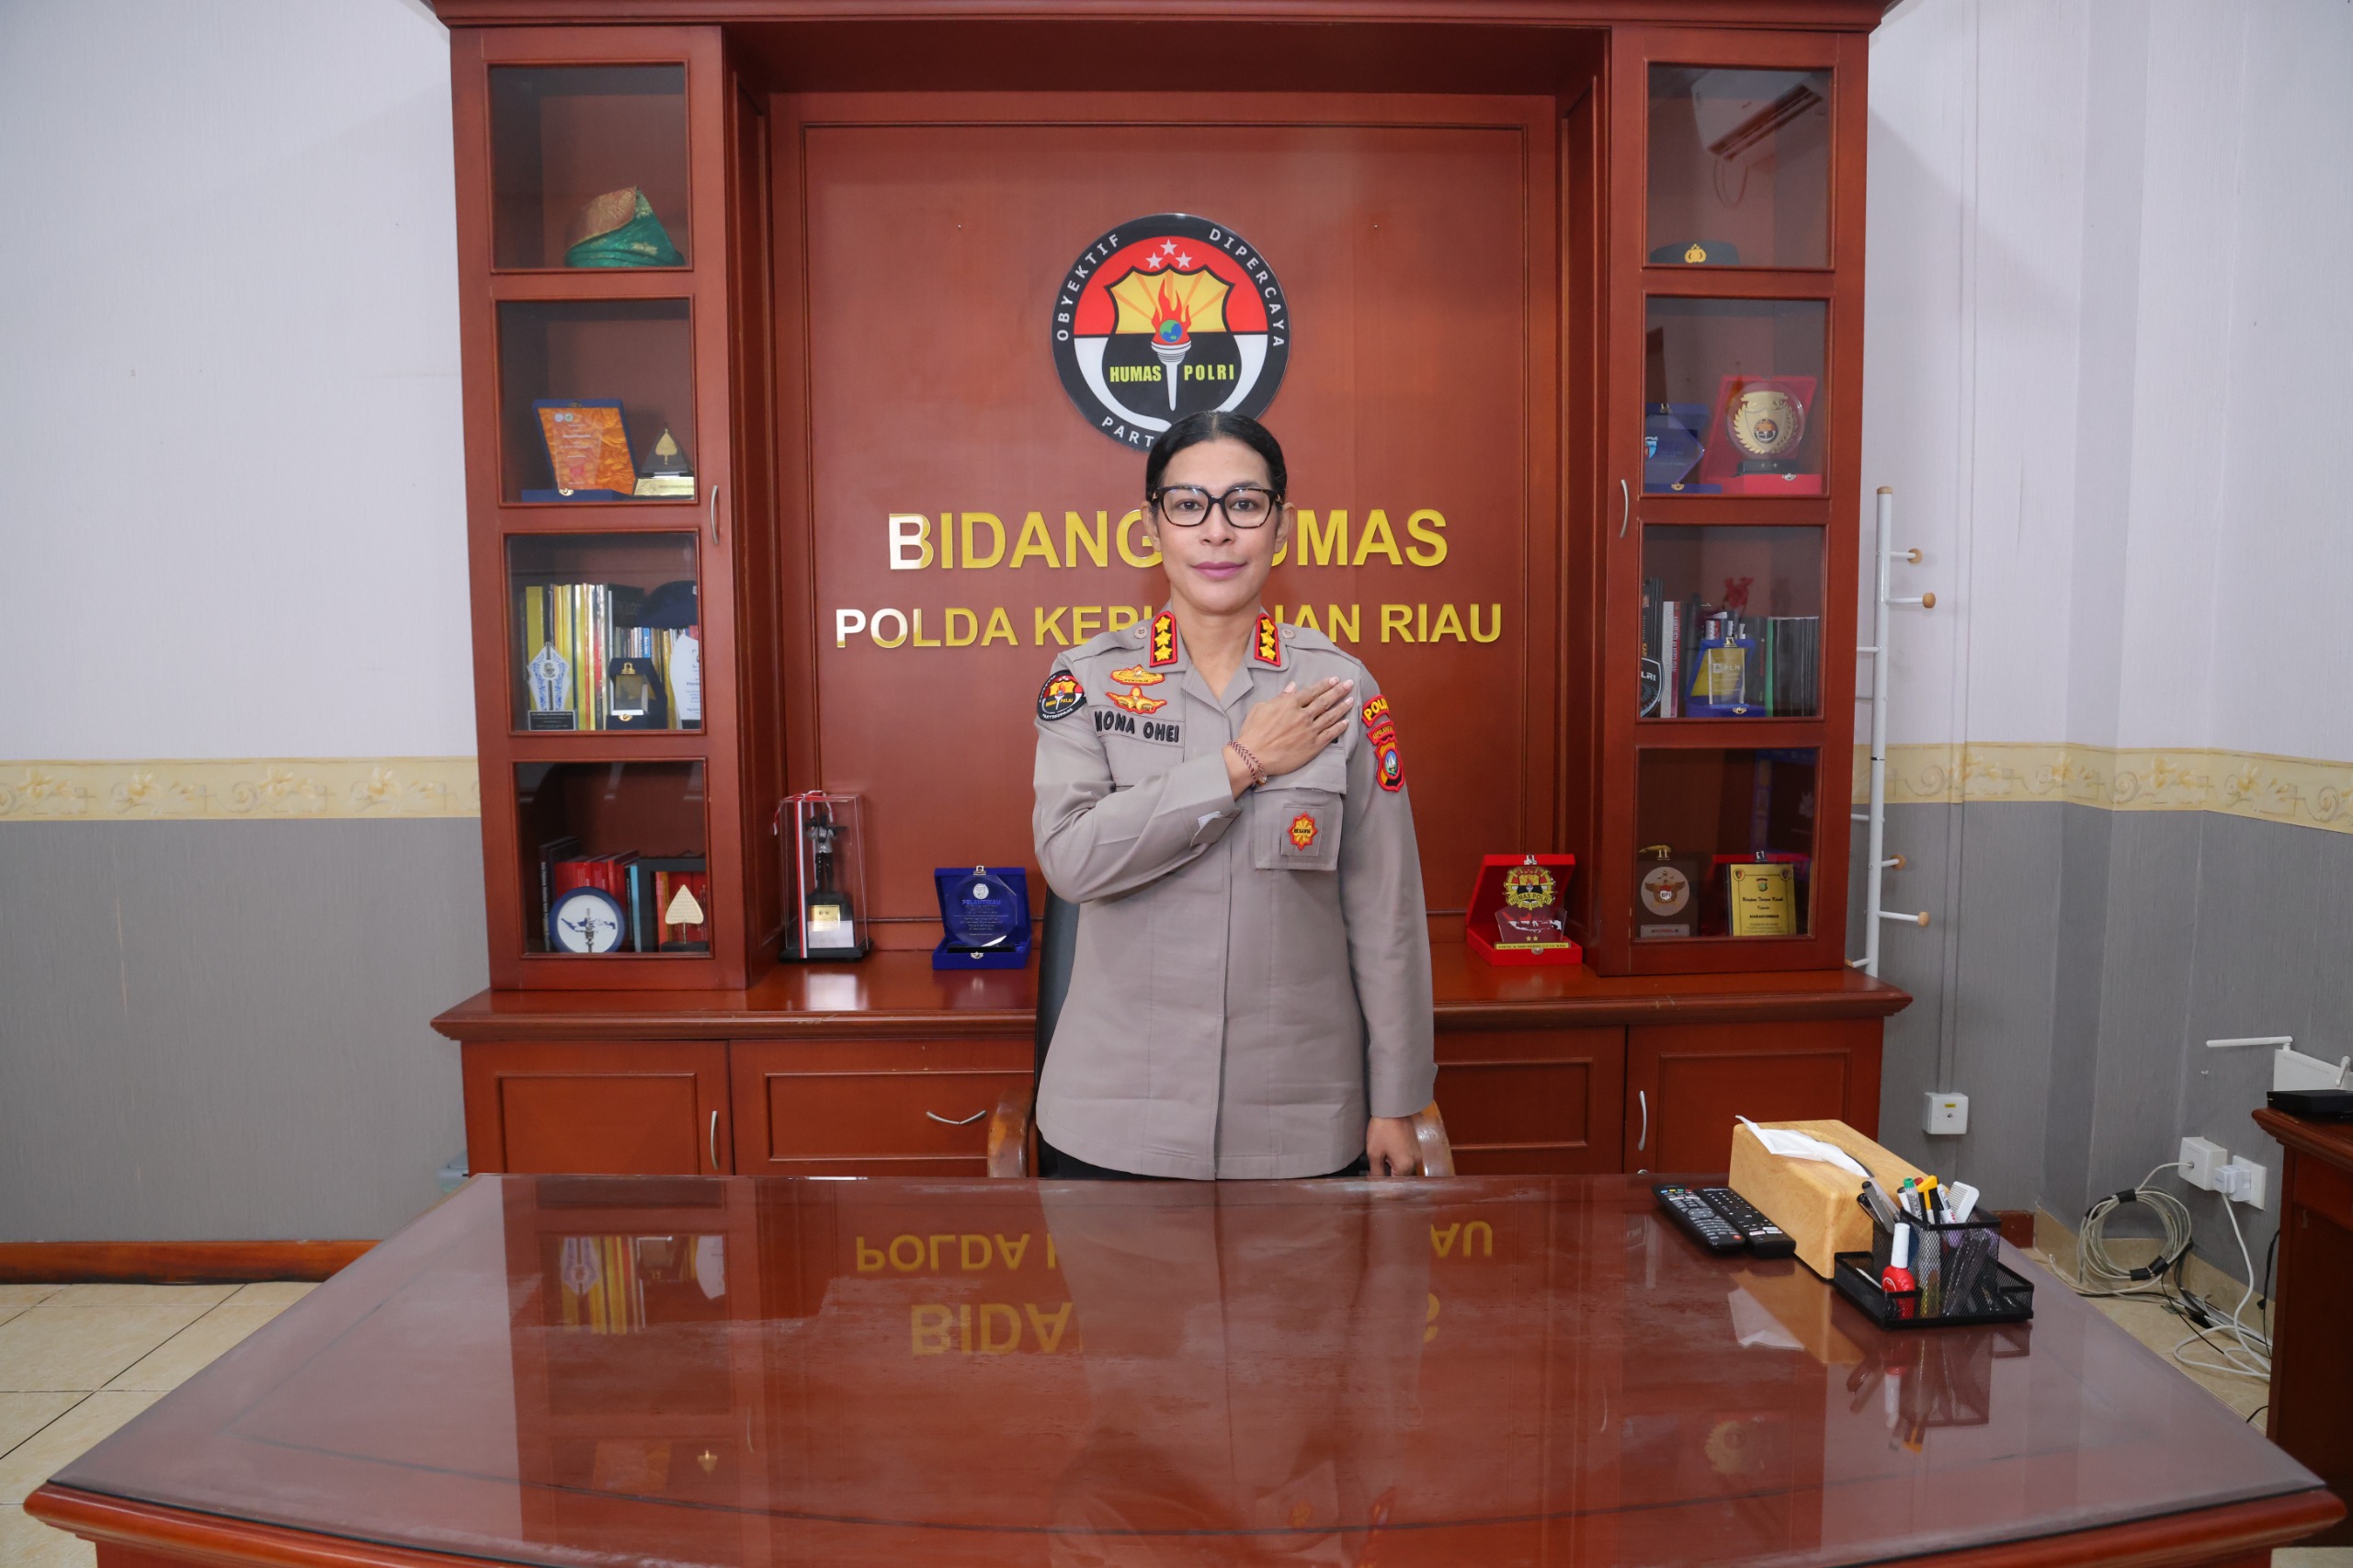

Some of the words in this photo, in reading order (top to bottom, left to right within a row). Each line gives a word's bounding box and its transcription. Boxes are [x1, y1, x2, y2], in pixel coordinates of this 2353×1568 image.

[1057, 233, 1120, 341] OBYEKTIF
[1209, 228, 1285, 347] DIPERCAYA
[1109, 365, 1162, 382] HUMAS
[1184, 364, 1234, 381] POLRI
[888, 508, 1163, 570] BIDANG
[1271, 508, 1449, 567] MAS
[835, 607, 1019, 649] POLDA
[1381, 603, 1502, 642] RIAU
[1641, 672, 1656, 682] LRI
[1142, 722, 1180, 743] OHEI
[1509, 893, 1531, 903] HUMAS
[1532, 892, 1551, 903] POLRI
